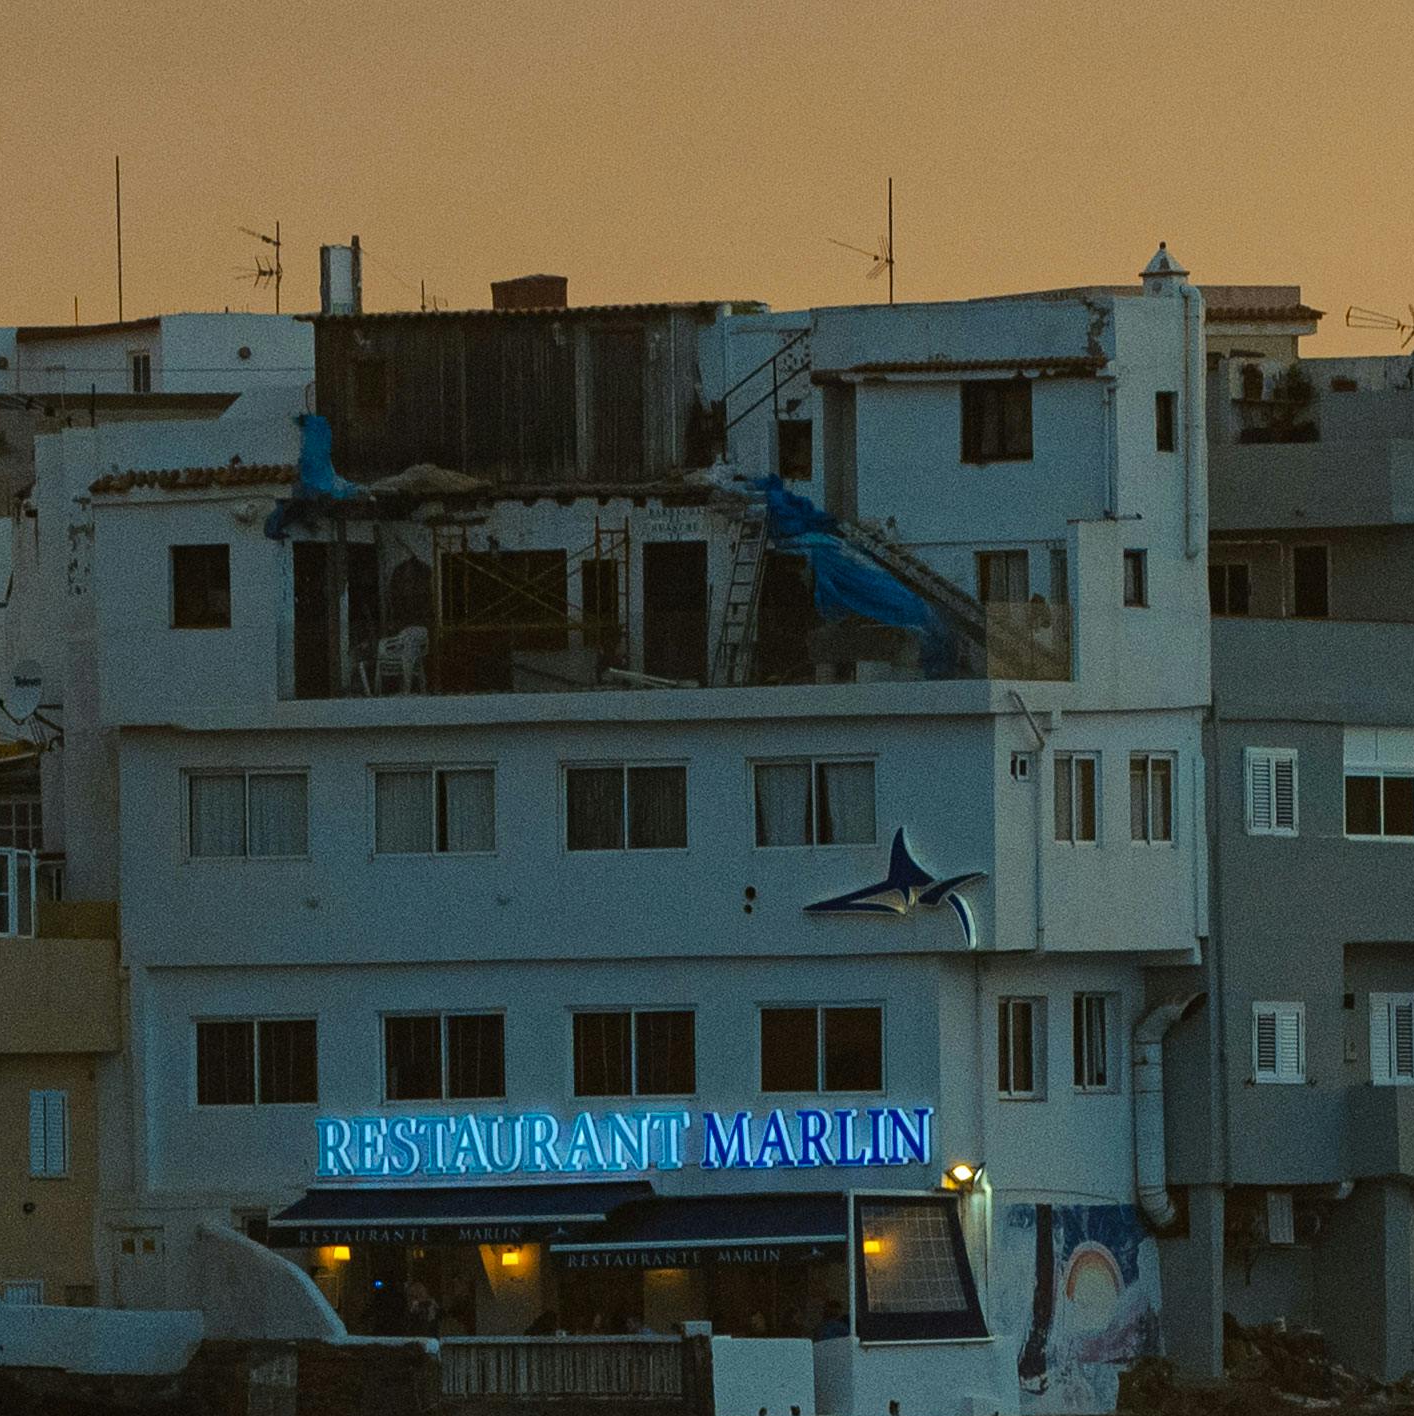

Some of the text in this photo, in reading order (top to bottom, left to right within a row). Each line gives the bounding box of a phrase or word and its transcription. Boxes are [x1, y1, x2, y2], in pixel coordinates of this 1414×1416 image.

[315, 1107, 935, 1176] RESTAURANT MARLIN
[298, 1227, 523, 1243] RESTAURANTE MARLIN
[567, 1249, 782, 1268] RESTAURANTE MARLIN
